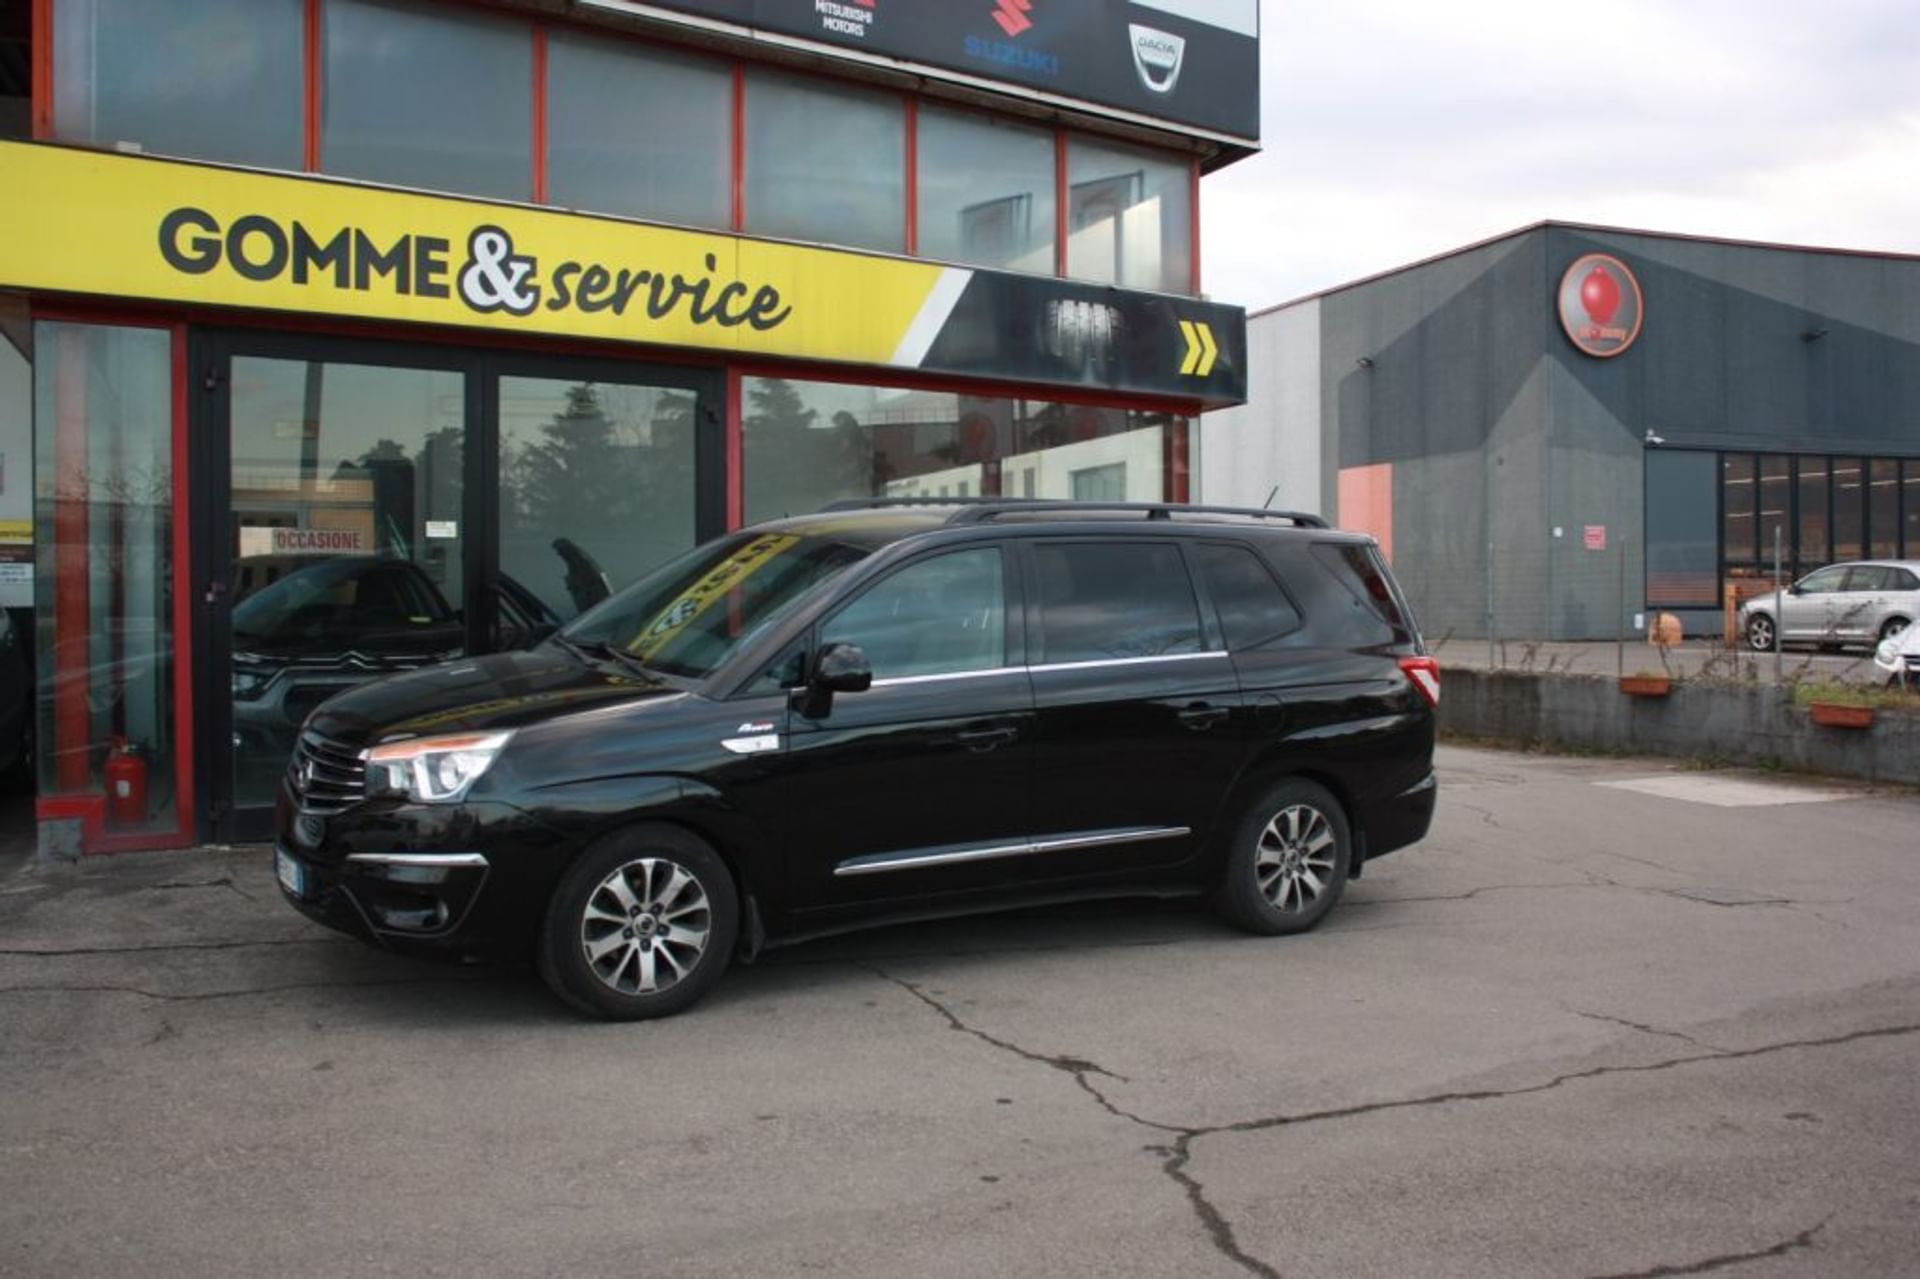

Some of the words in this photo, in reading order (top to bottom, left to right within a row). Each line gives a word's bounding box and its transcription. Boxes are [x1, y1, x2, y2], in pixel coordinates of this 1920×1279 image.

[815, 0, 873, 24] MITSUBISHI
[823, 15, 864, 37] MOTORS
[963, 35, 1058, 75] SUZUKI
[1138, 36, 1175, 54] DACIA
[158, 206, 450, 299] GOMME
[546, 253, 792, 331] service
[277, 532, 361, 549] OCCASIONE
